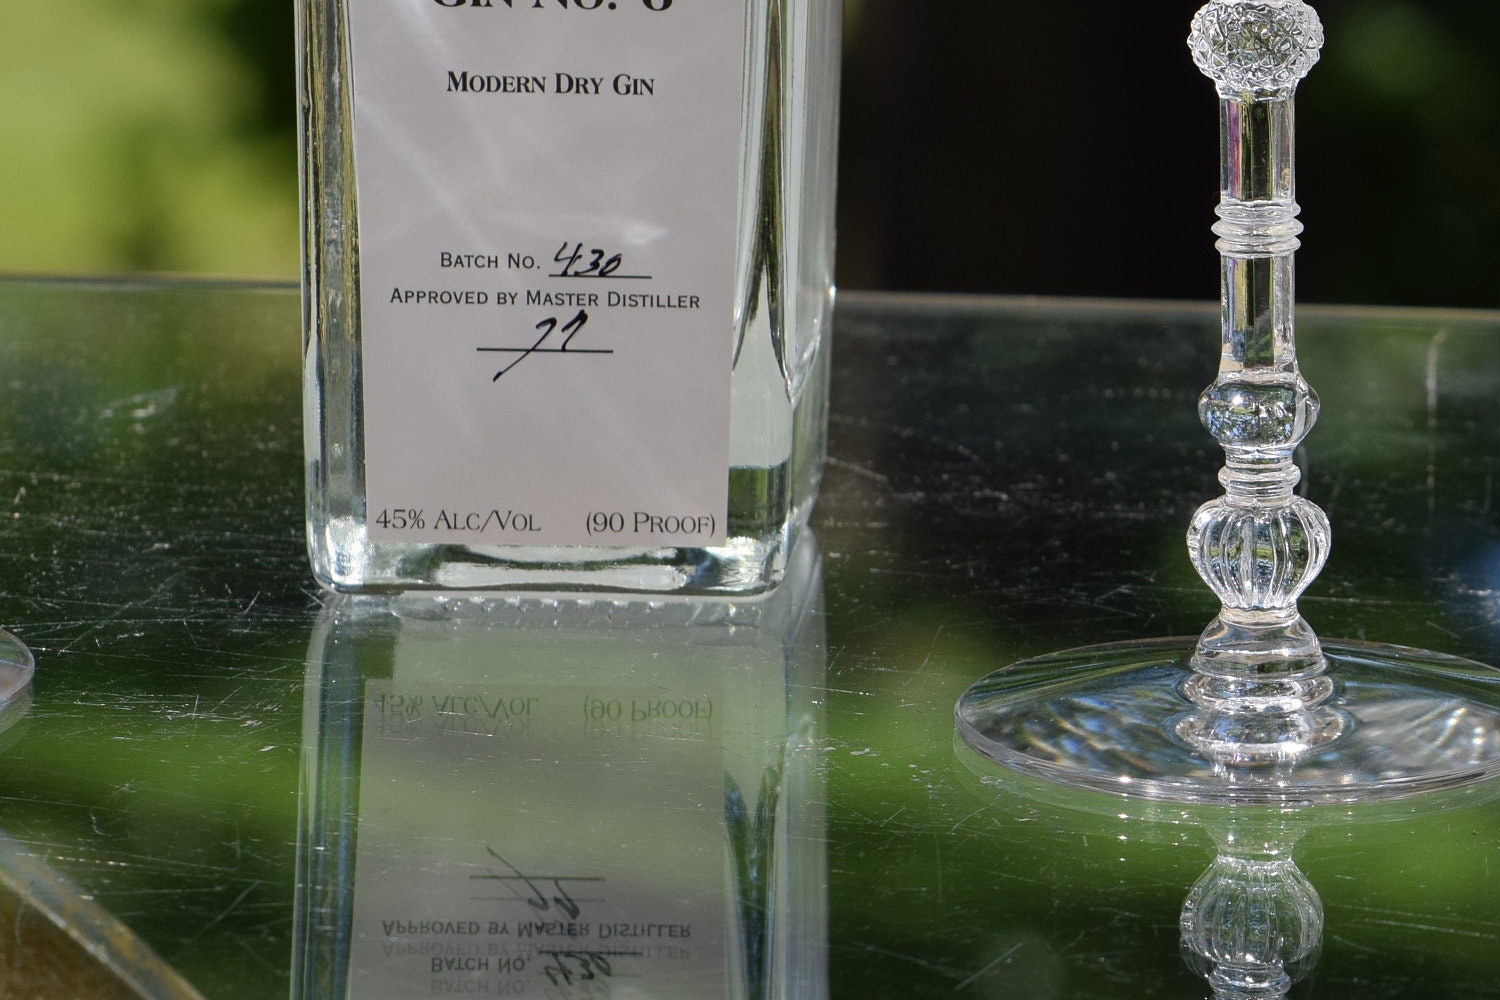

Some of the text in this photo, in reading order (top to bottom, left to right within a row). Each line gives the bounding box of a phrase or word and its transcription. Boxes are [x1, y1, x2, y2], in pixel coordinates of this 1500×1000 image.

[446, 70, 655, 96] MODERN DRY GIN
[440, 241, 623, 277] BATCH NO. 430
[389, 287, 700, 309] APPROVED BY MASTER DISTILLER
[375, 508, 716, 537] 45% ALC/VOL (90 PROOF)
